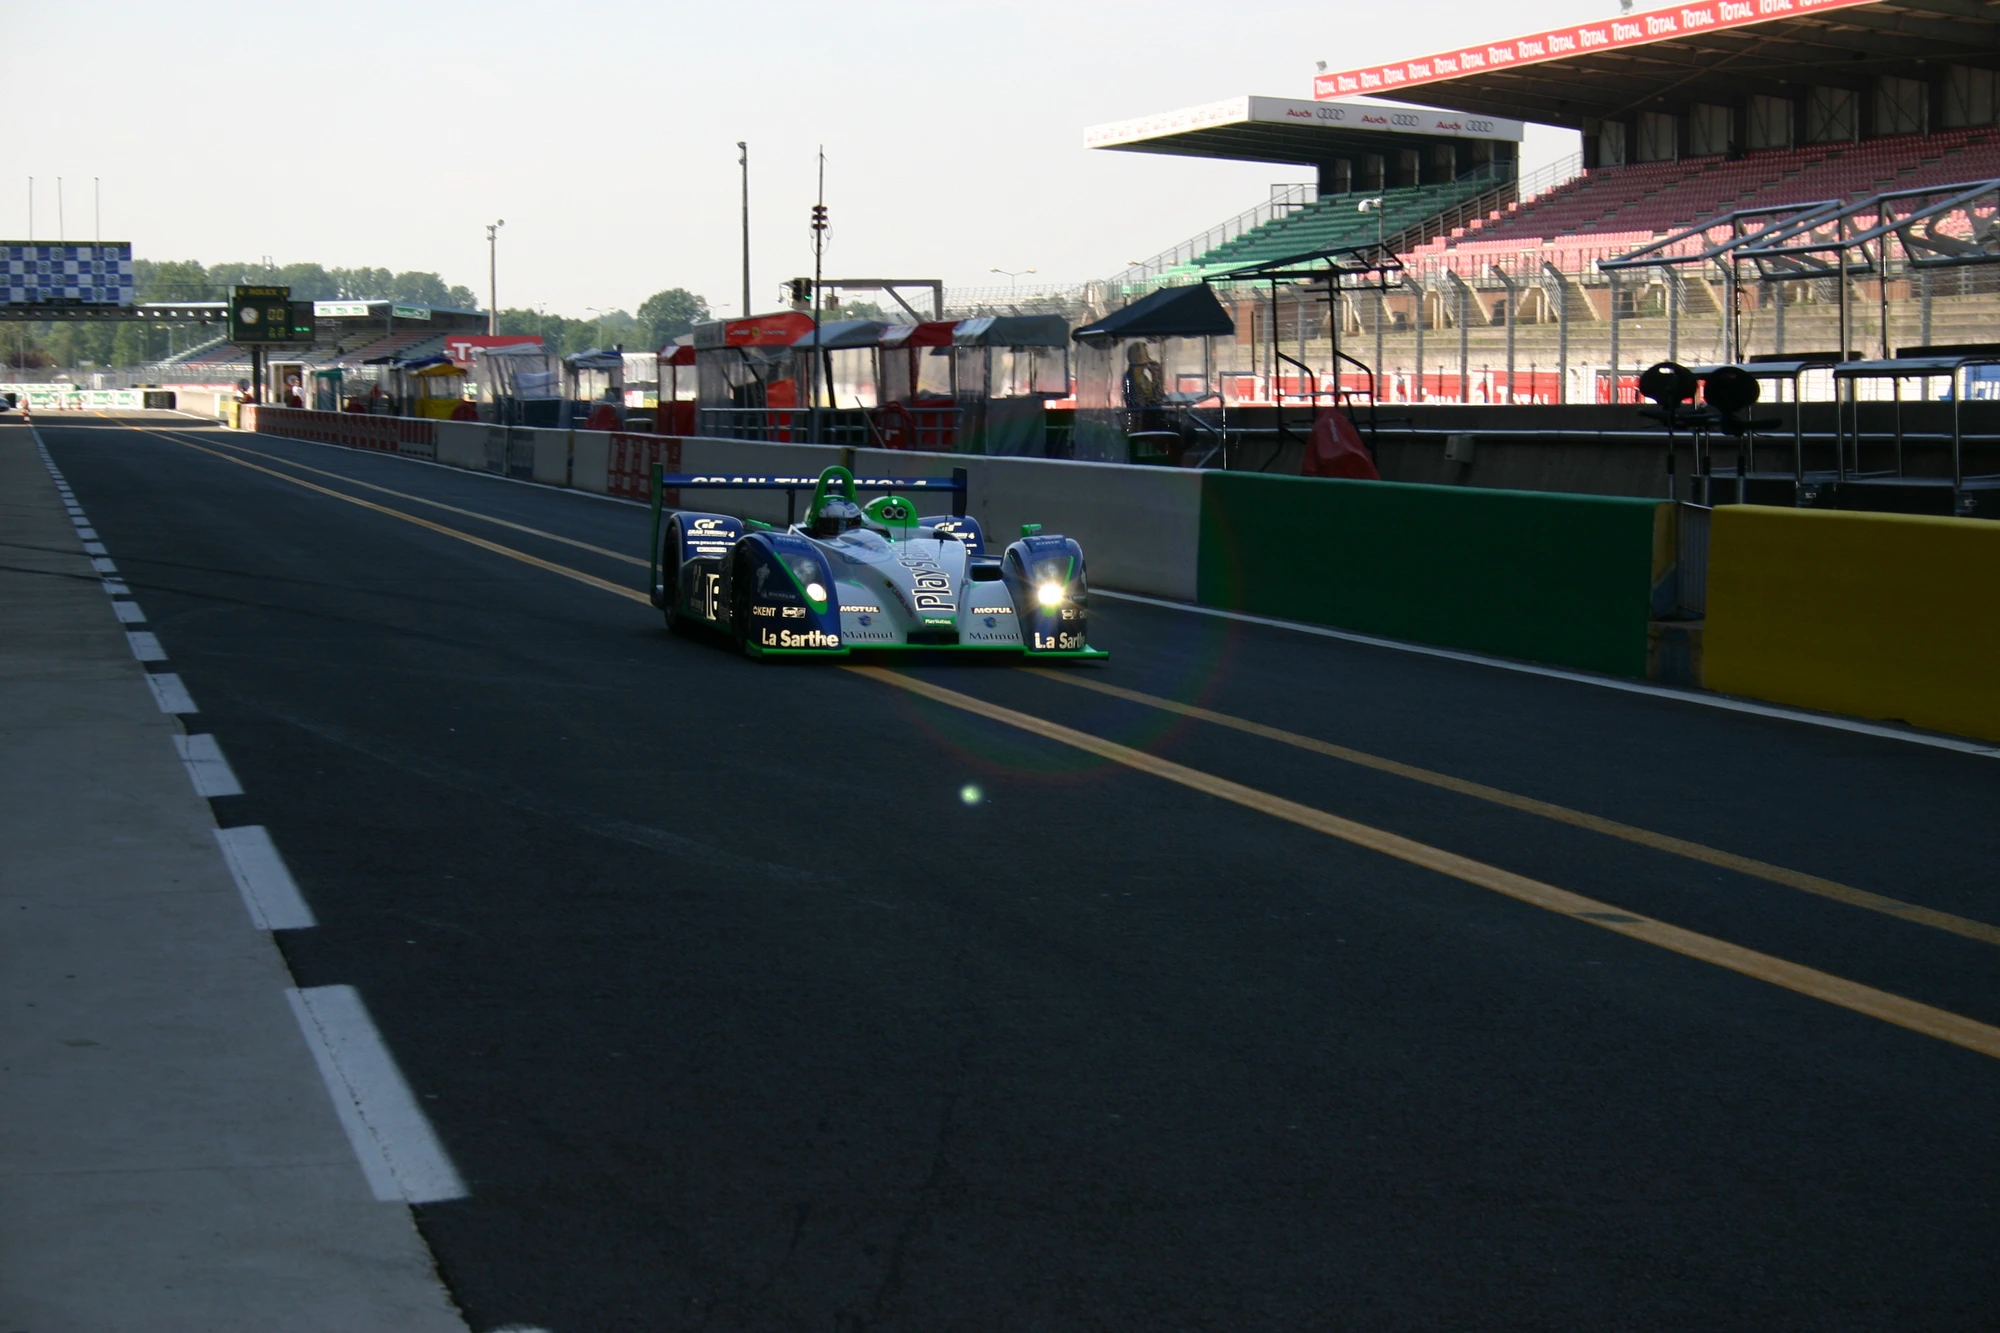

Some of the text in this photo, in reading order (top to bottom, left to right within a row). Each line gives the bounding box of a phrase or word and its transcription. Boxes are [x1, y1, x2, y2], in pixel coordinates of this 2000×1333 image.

[1360, 72, 1382, 88] TOTAL
[1383, 68, 1405, 84] TOTAL
[1408, 63, 1431, 79] TOTAL
[1434, 57, 1458, 74] TOTAL
[1460, 52, 1485, 69] TOTAL
[1488, 46, 1513, 64] TOTAL
[1517, 41, 1545, 58] TOTAL
[1547, 35, 1576, 52] TOTAL
[1579, 29, 1608, 46] TOTAL
[1612, 23, 1642, 41] TOTAL
[1646, 16, 1677, 34] TOTAL
[1681, 9, 1714, 28] TOTAL
[1718, 2, 1754, 21] TOTAL
[1286, 108, 1462, 131] Audi Audi Audi
[840, 605, 879, 613] MOTUL
[762, 628, 839, 648] La Sarthe
[843, 631, 894, 640] Matmut
[970, 632, 1020, 640] Matmut
[1034, 632, 1056, 649] La
